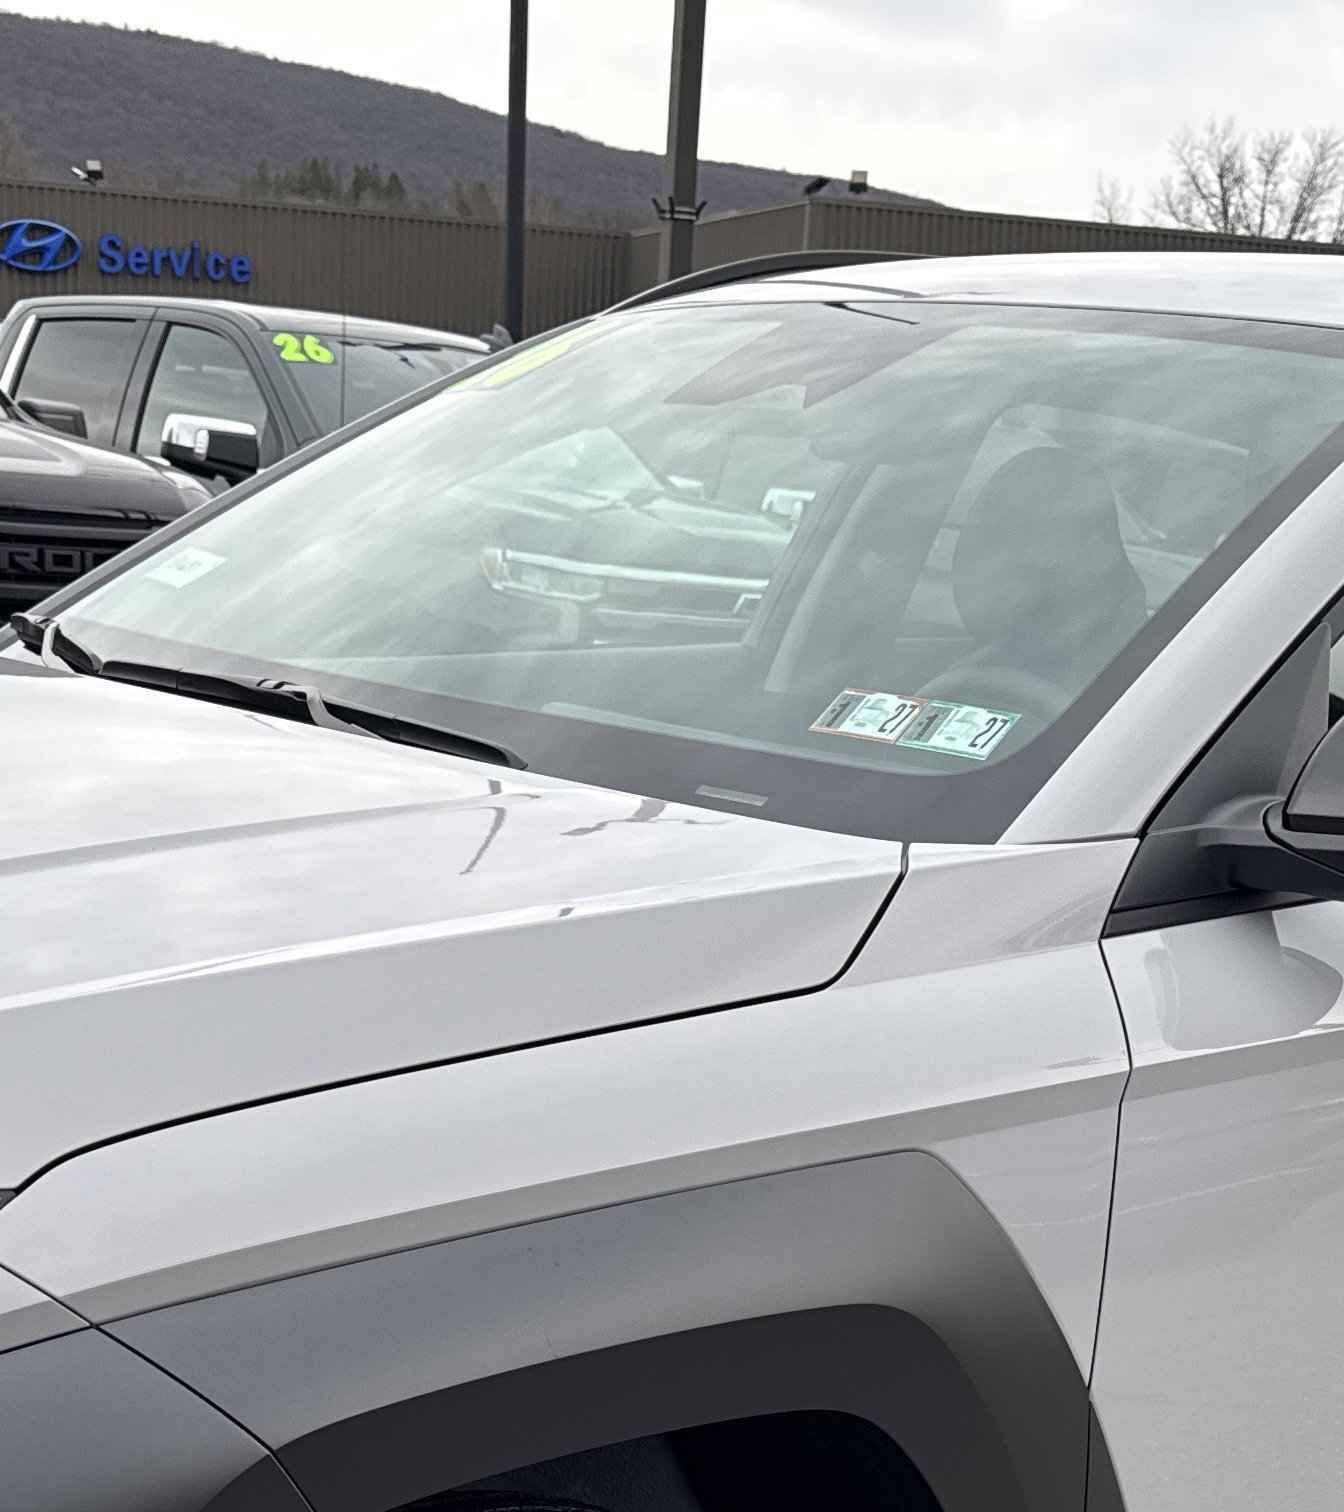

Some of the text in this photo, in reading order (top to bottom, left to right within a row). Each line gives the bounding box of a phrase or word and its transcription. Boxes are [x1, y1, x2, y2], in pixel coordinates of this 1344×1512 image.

[97, 233, 252, 283] Service
[272, 332, 335, 364] 26
[877, 702, 918, 735] 27
[968, 716, 1011, 750] 27
